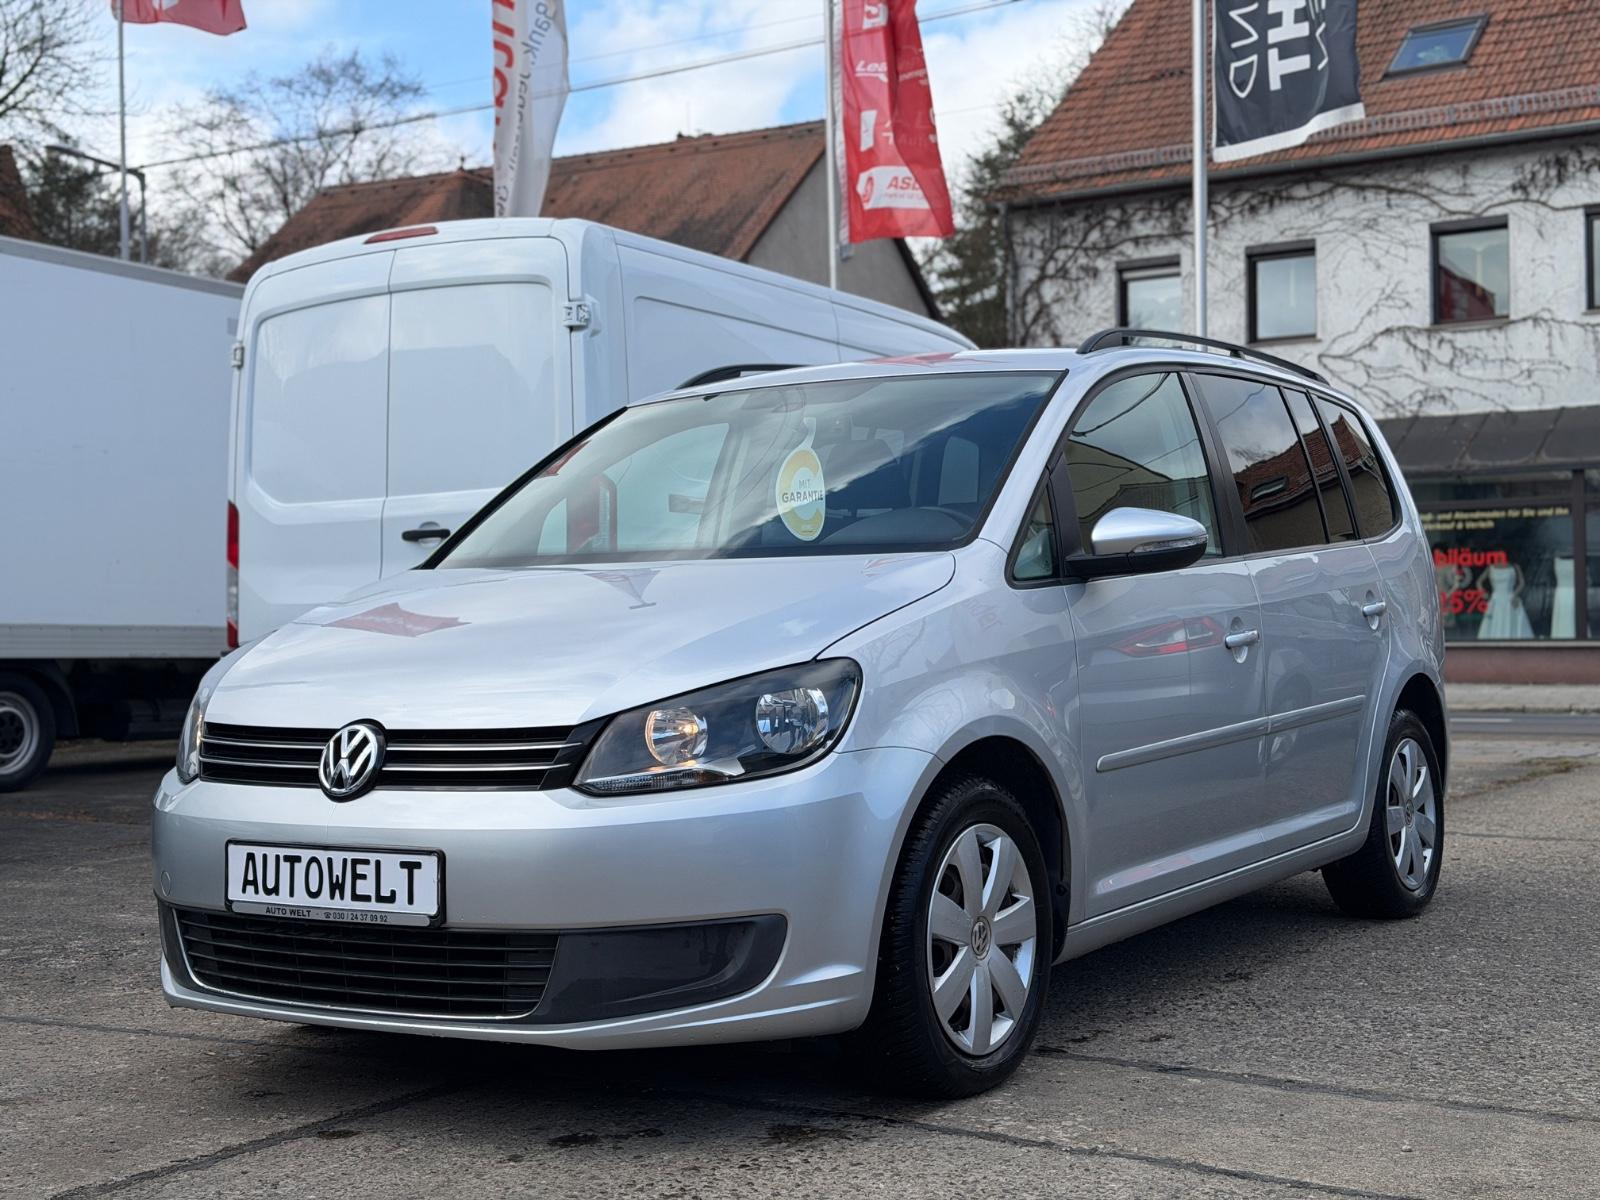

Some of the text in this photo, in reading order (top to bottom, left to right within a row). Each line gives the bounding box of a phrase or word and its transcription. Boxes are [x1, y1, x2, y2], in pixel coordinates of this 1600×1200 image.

[798, 480, 811, 489] MIT
[782, 491, 824, 503] GARANTIE
[241, 851, 423, 906] AUTOWELT
[265, 906, 287, 916] AUTO
[289, 908, 312, 918] WELT
[332, 910, 345, 920] 030
[350, 912, 359, 921] 24
[360, 912, 368, 921] 37
[369, 913, 378, 922] 09
[379, 914, 388, 923] 92
